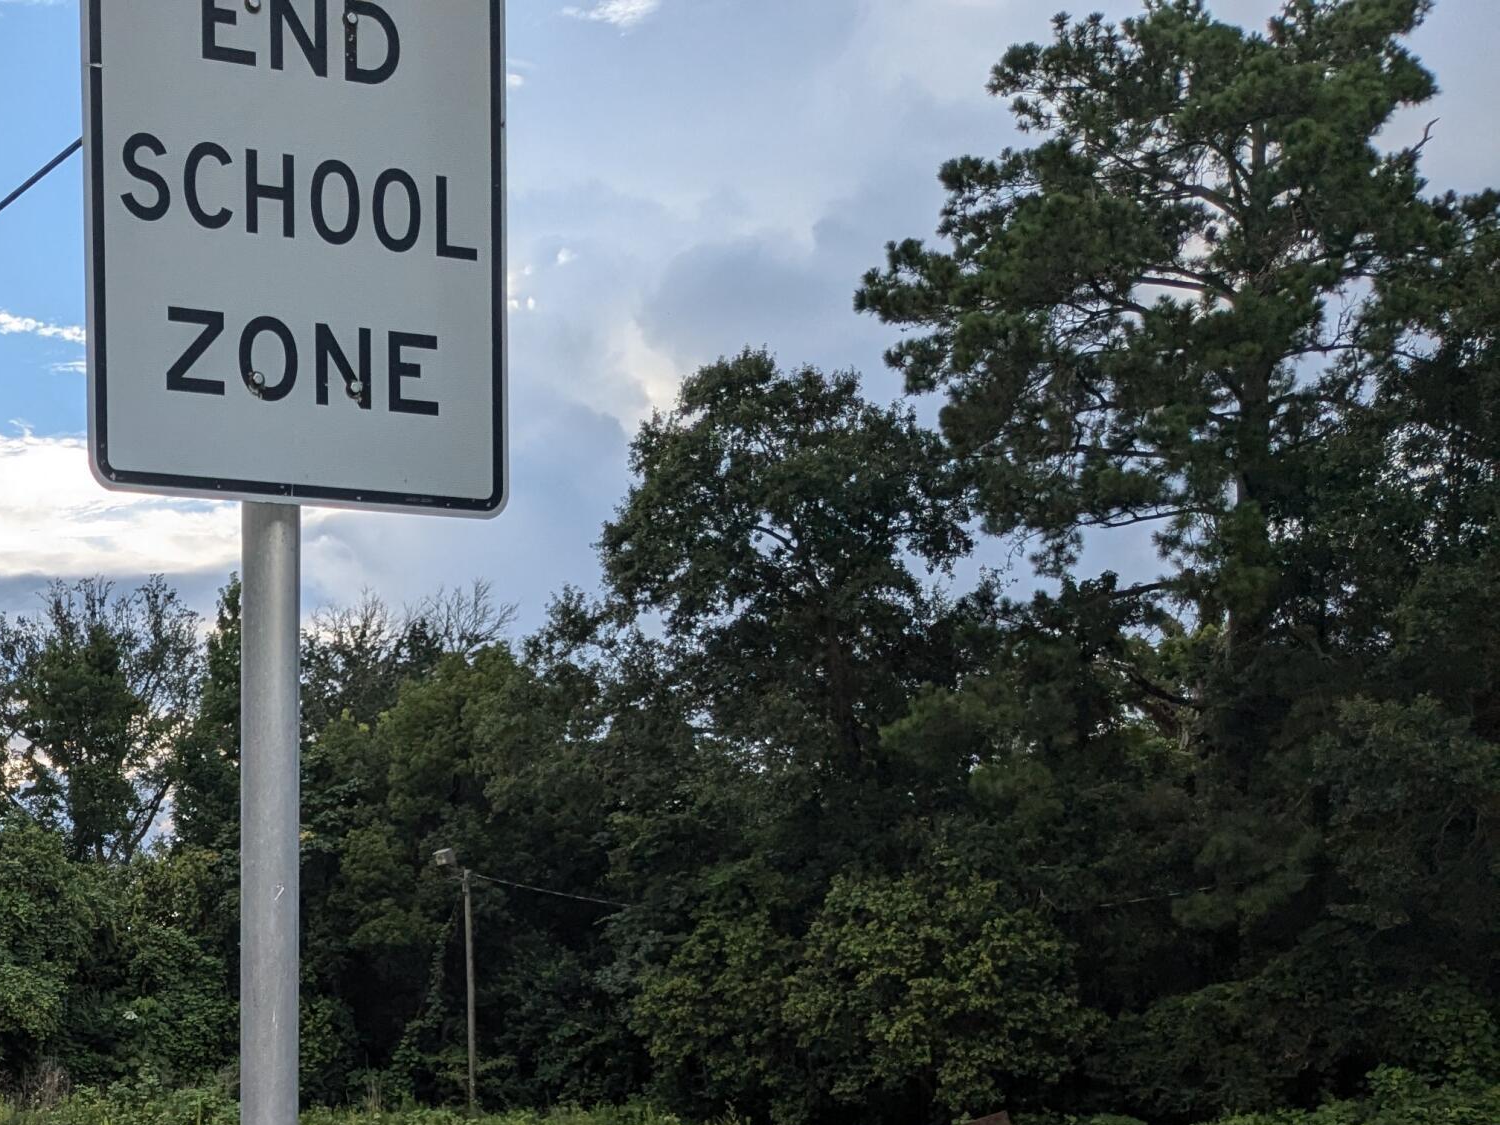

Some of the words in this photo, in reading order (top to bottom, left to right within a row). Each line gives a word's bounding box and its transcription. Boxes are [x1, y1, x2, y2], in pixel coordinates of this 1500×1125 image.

[201, 0, 400, 85] END
[120, 132, 478, 261] SCHOOL
[166, 306, 439, 416] ZONE
